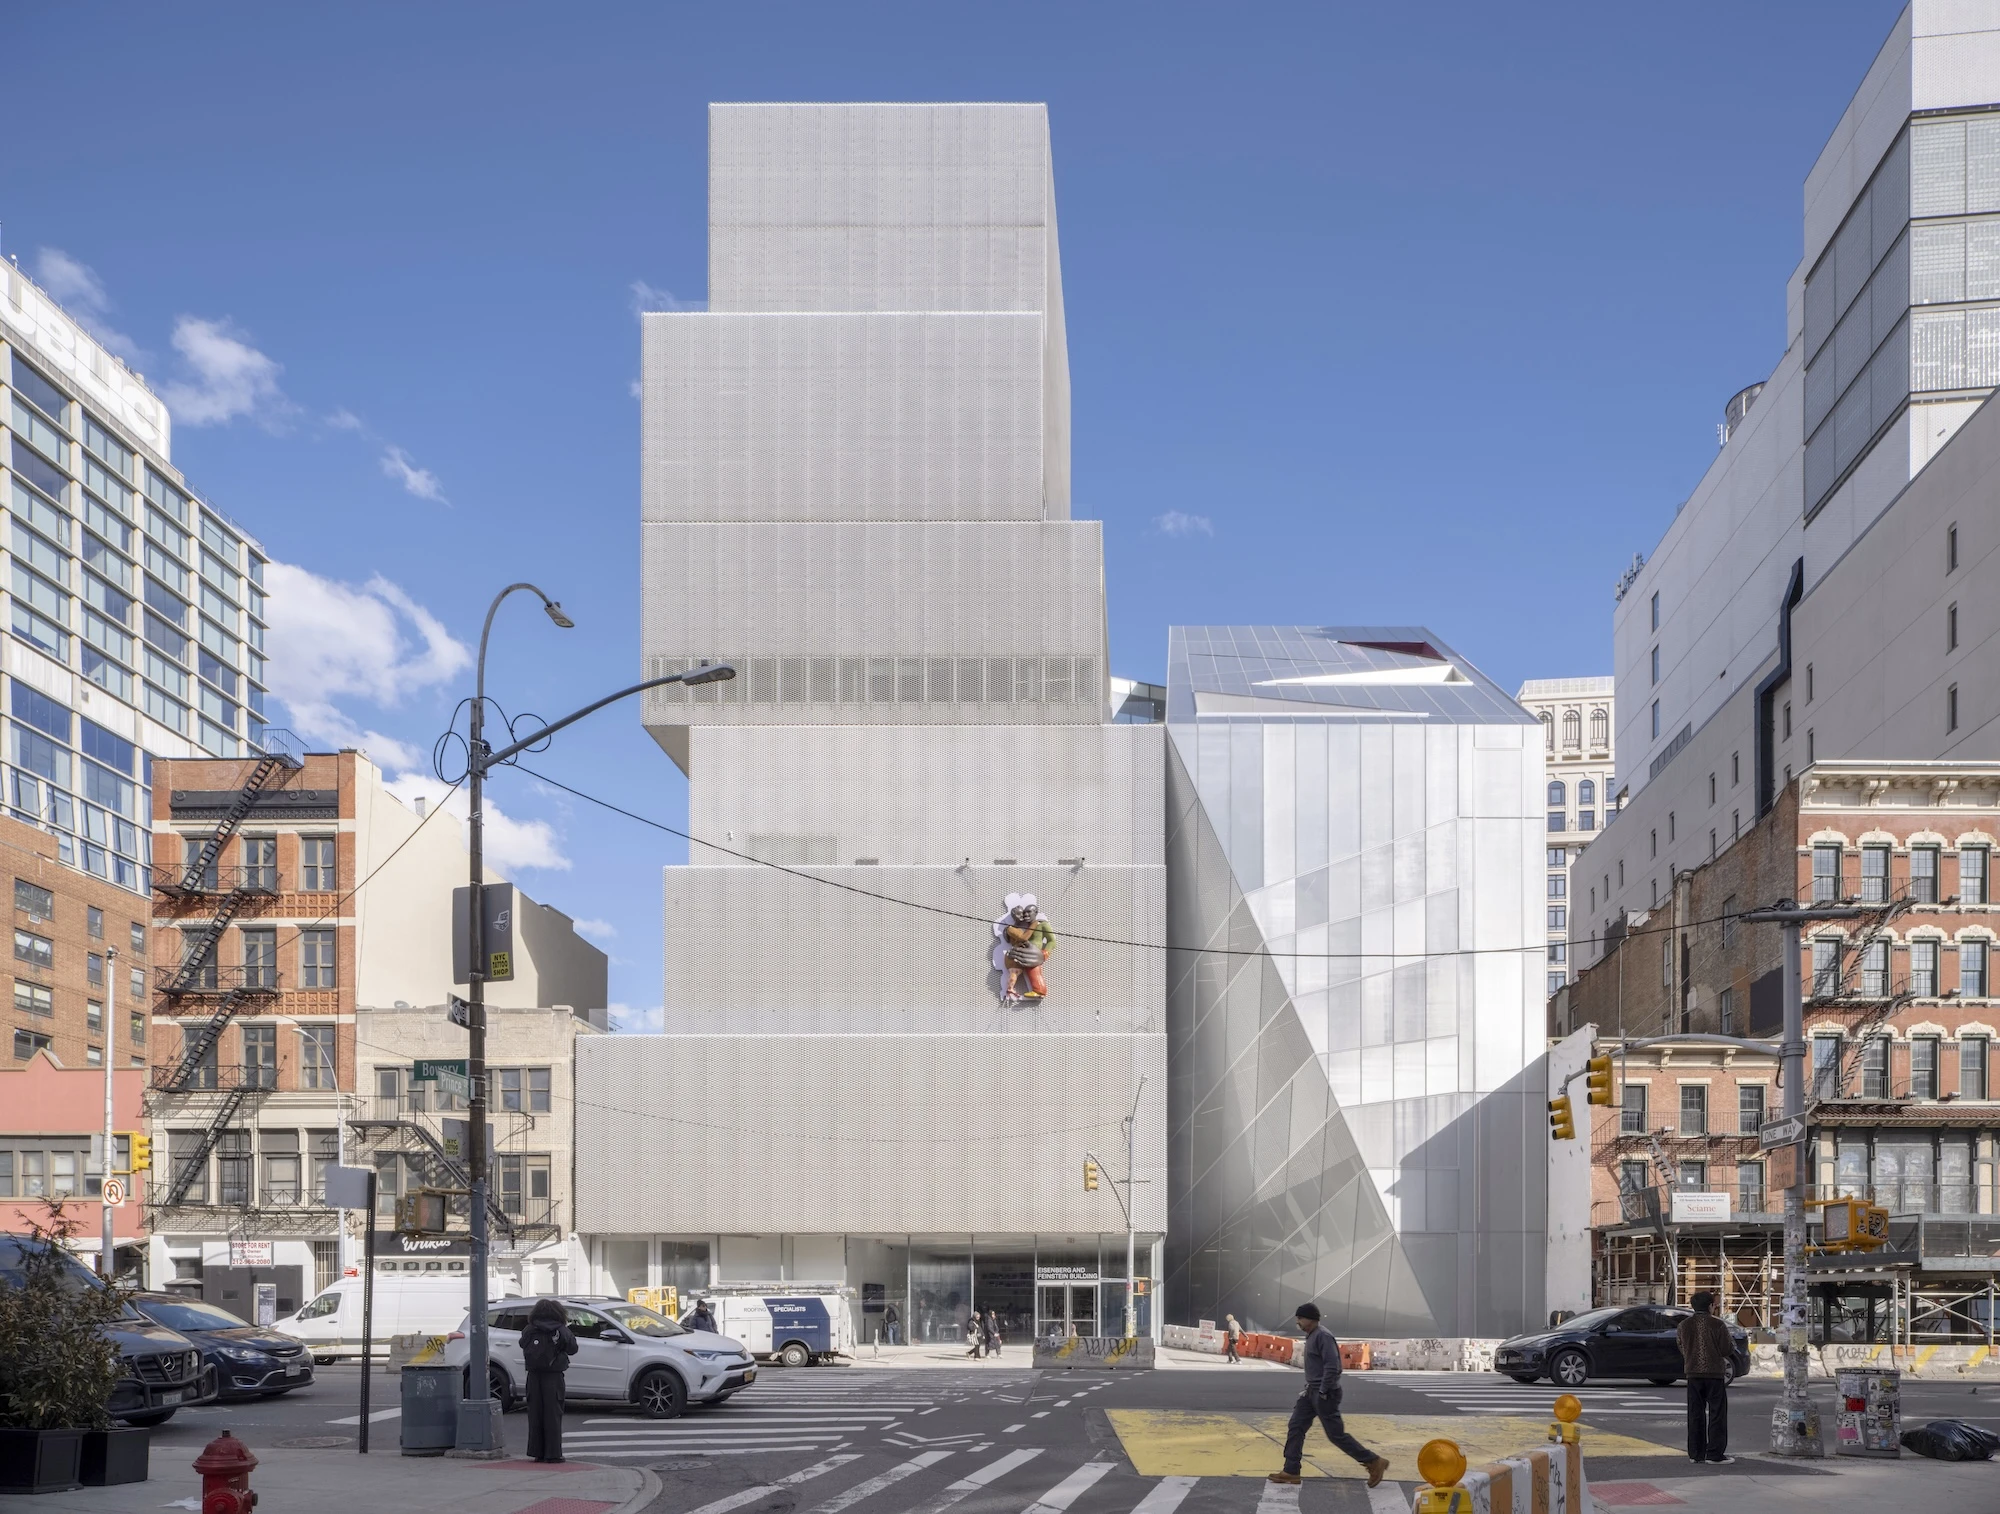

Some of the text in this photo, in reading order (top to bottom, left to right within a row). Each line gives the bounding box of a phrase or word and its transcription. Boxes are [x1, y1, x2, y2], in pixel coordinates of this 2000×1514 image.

[492, 960, 508, 969] TATTOO
[493, 968, 509, 976] SHOP
[441, 1073, 462, 1093] Prince
[1764, 1123, 1797, 1141] ONE WAY
[1687, 1203, 1717, 1212] Sciame
